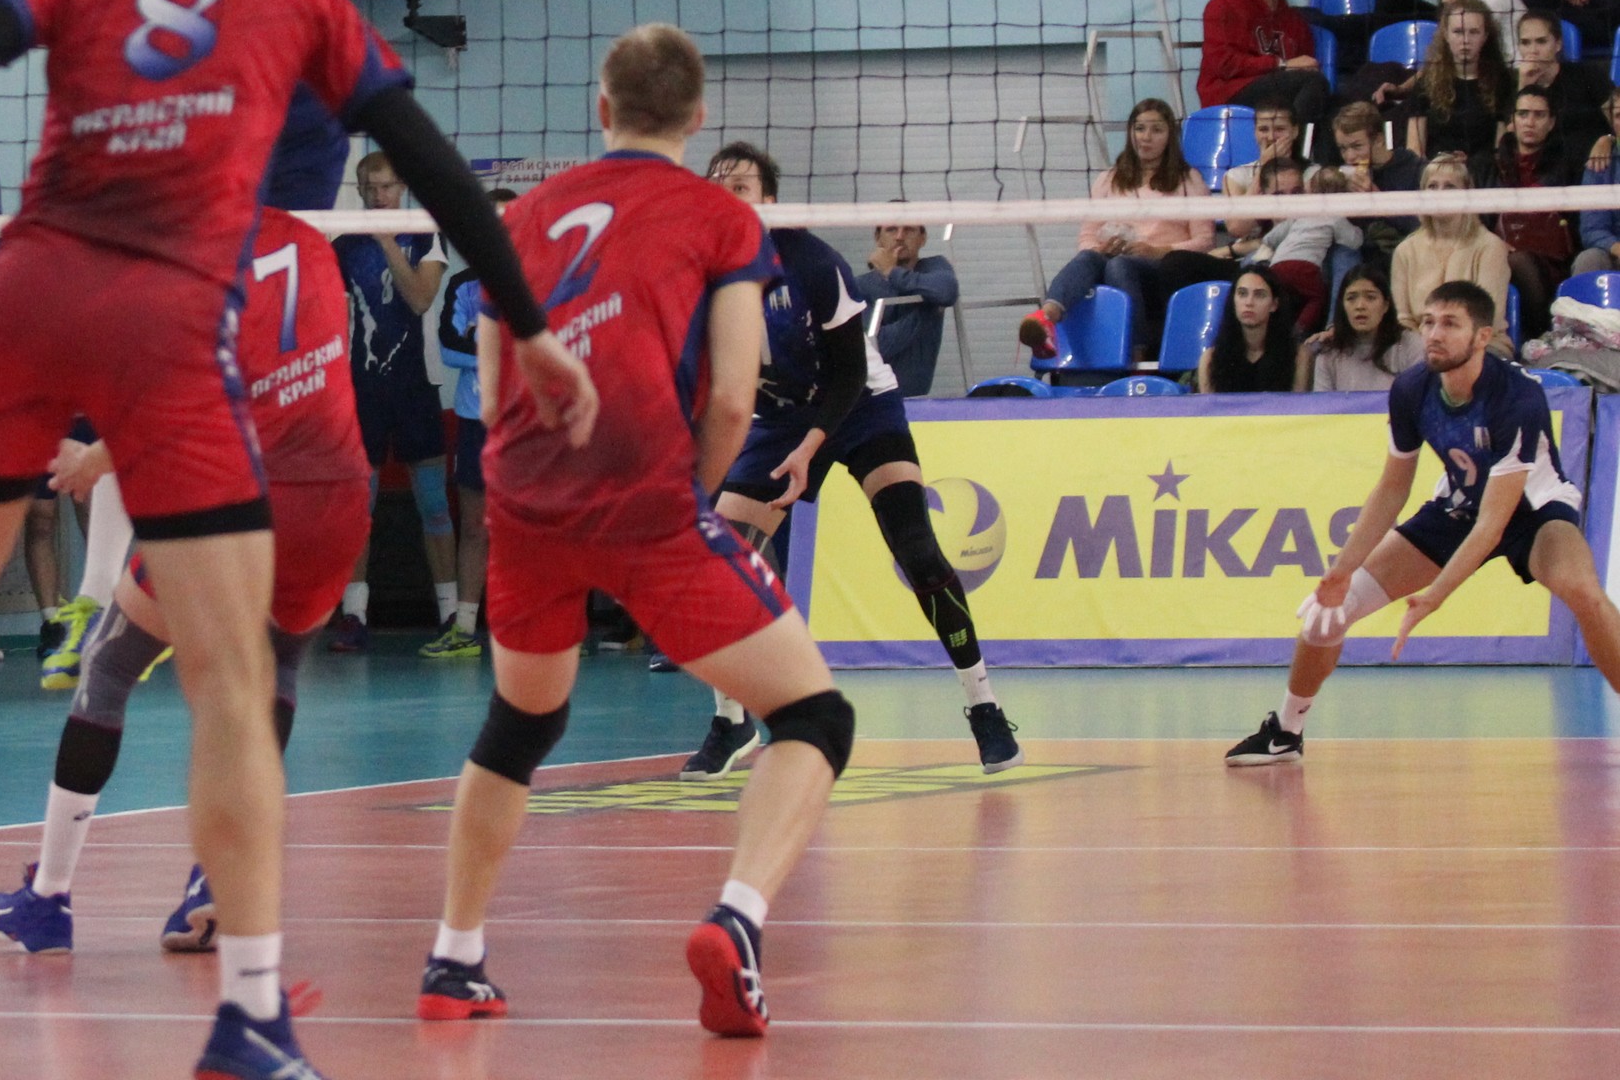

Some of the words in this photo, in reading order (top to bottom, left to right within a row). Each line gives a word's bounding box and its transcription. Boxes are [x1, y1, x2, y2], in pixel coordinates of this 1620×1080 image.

[381, 267, 394, 305] 8
[542, 201, 616, 313] 2
[251, 241, 299, 355] 7
[278, 367, 327, 408] КРАЙ
[1448, 447, 1478, 487] 9
[1034, 495, 1365, 580] MIKAS
